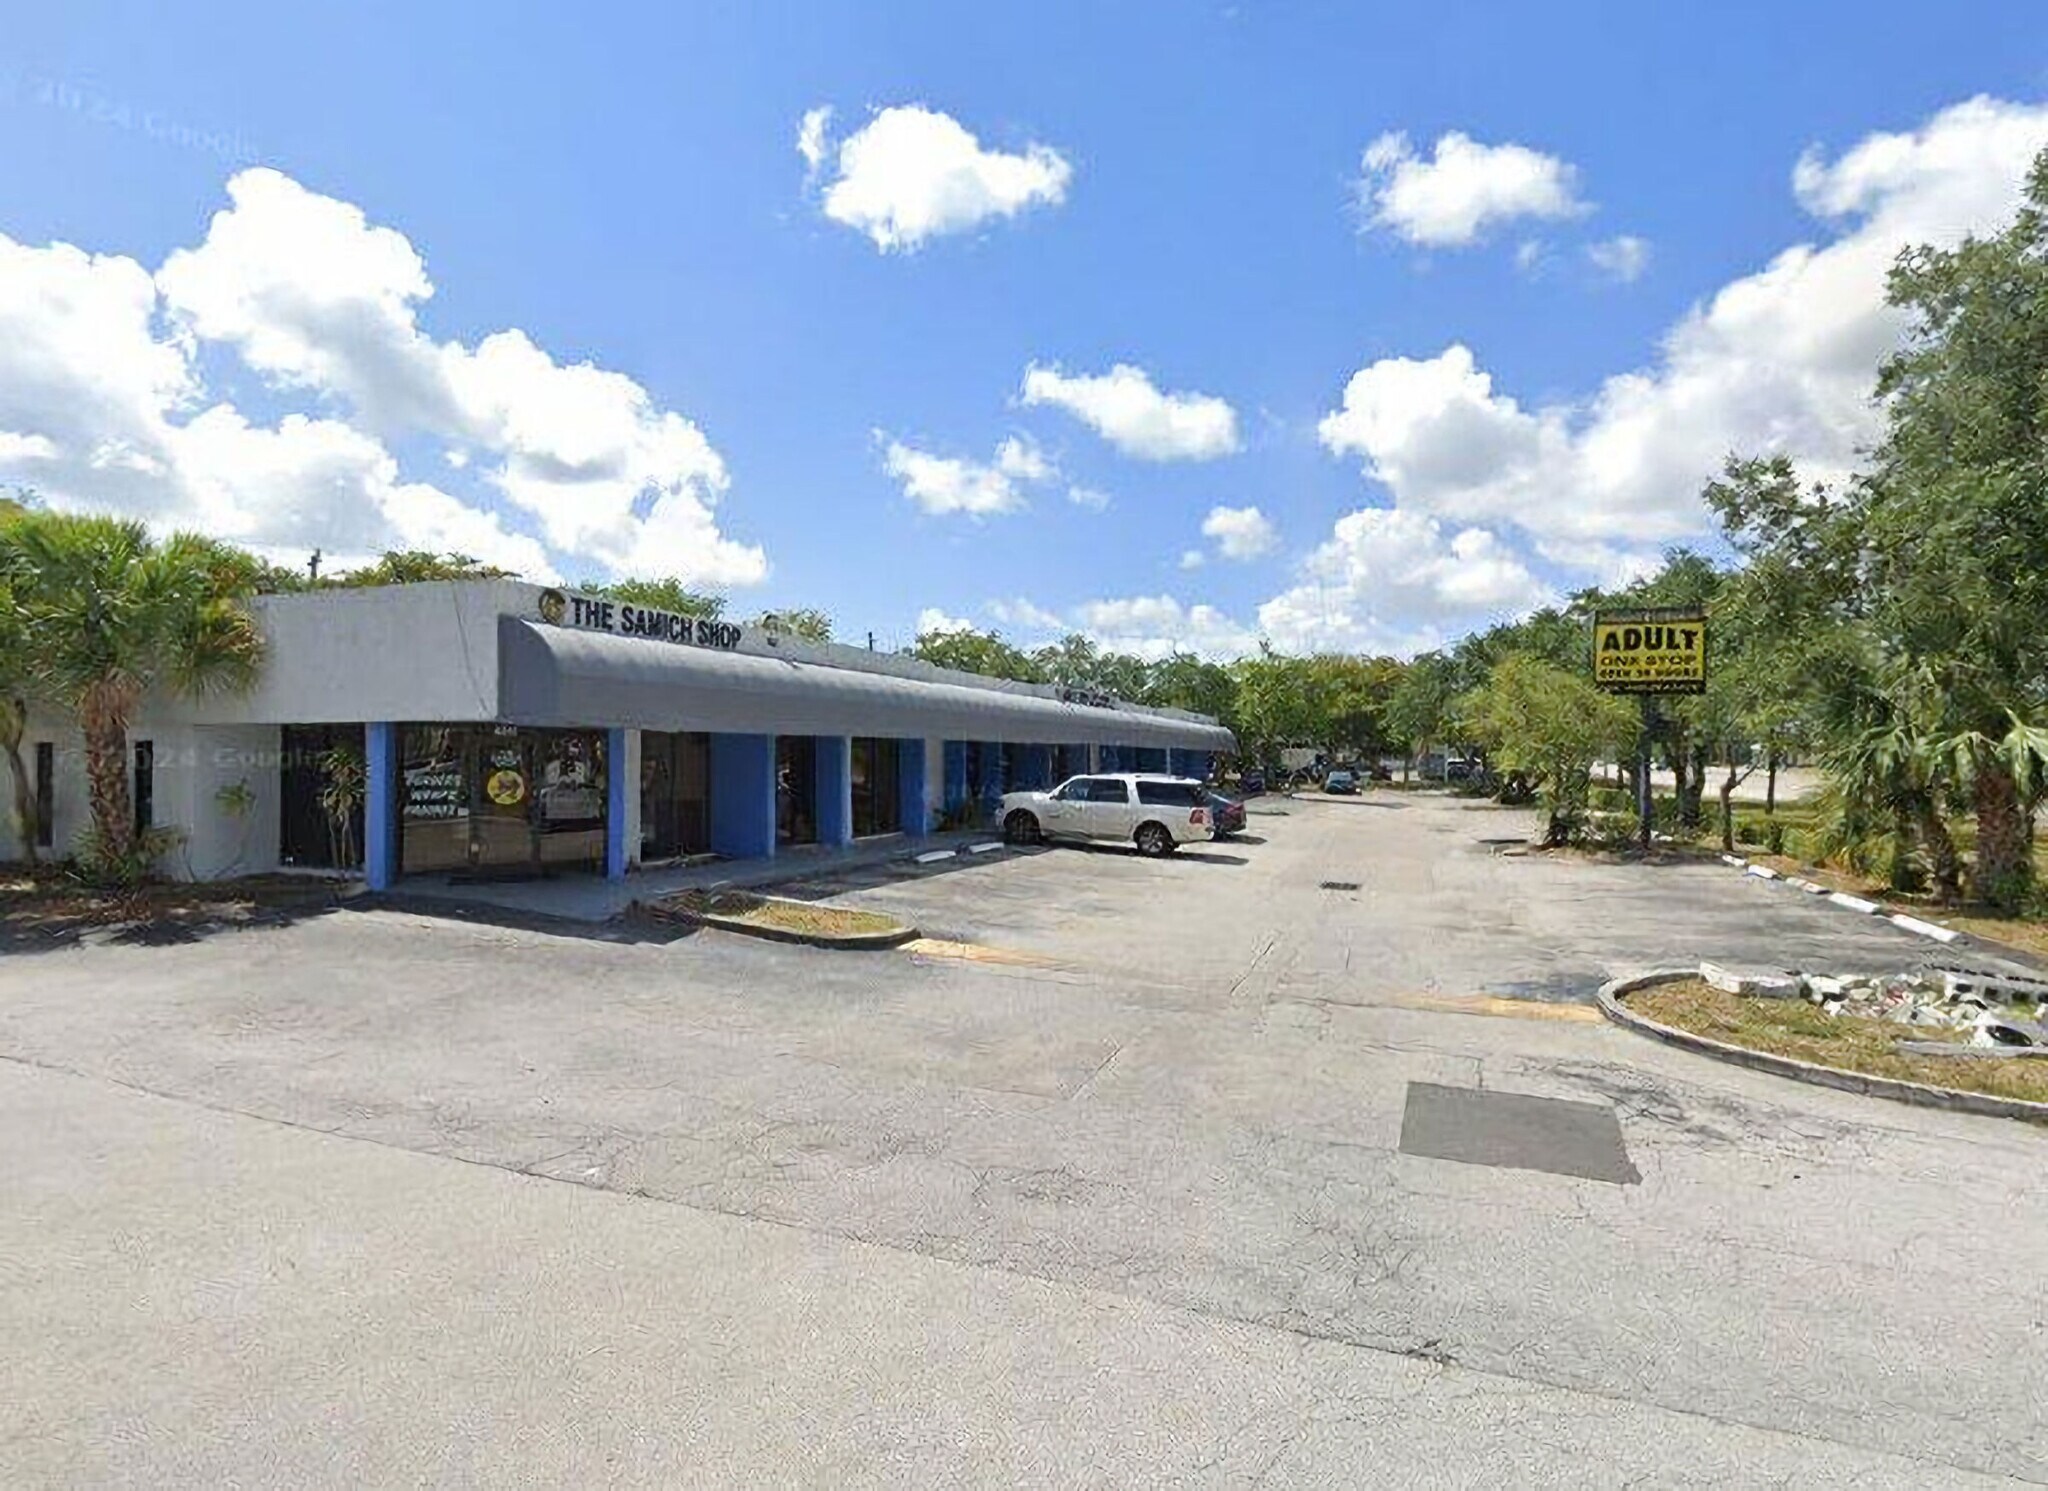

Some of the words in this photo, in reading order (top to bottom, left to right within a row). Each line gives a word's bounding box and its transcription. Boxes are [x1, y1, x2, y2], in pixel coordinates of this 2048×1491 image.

[571, 597, 614, 630] THE
[697, 619, 742, 649] SHOP
[1602, 626, 1699, 651] ADULT
